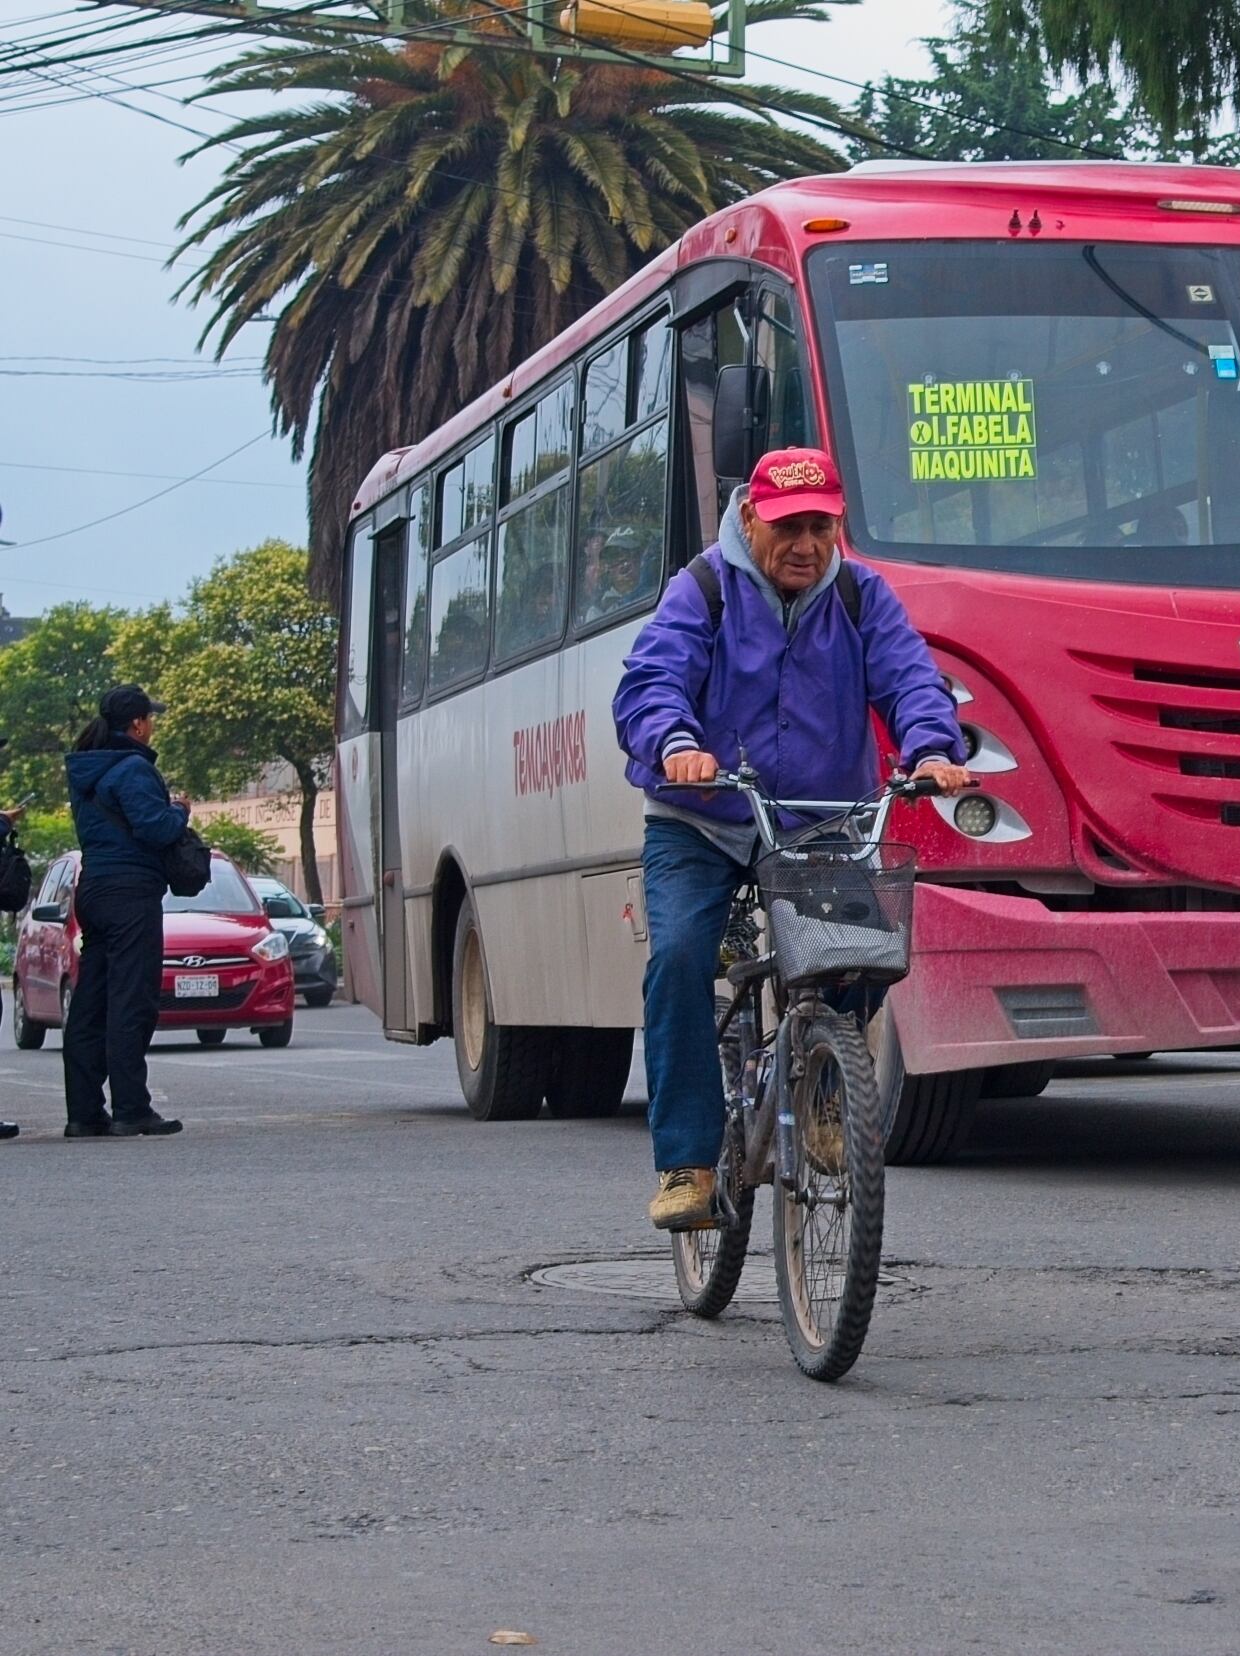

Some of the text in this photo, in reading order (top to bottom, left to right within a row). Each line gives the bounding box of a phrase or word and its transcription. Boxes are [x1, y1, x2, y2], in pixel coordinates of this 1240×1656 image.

[908, 382, 1032, 414] TERMINAL
[932, 414, 1032, 445] I.FABELA
[911, 449, 1034, 480] MAQUINITA
[319, 798, 331, 819] DE
